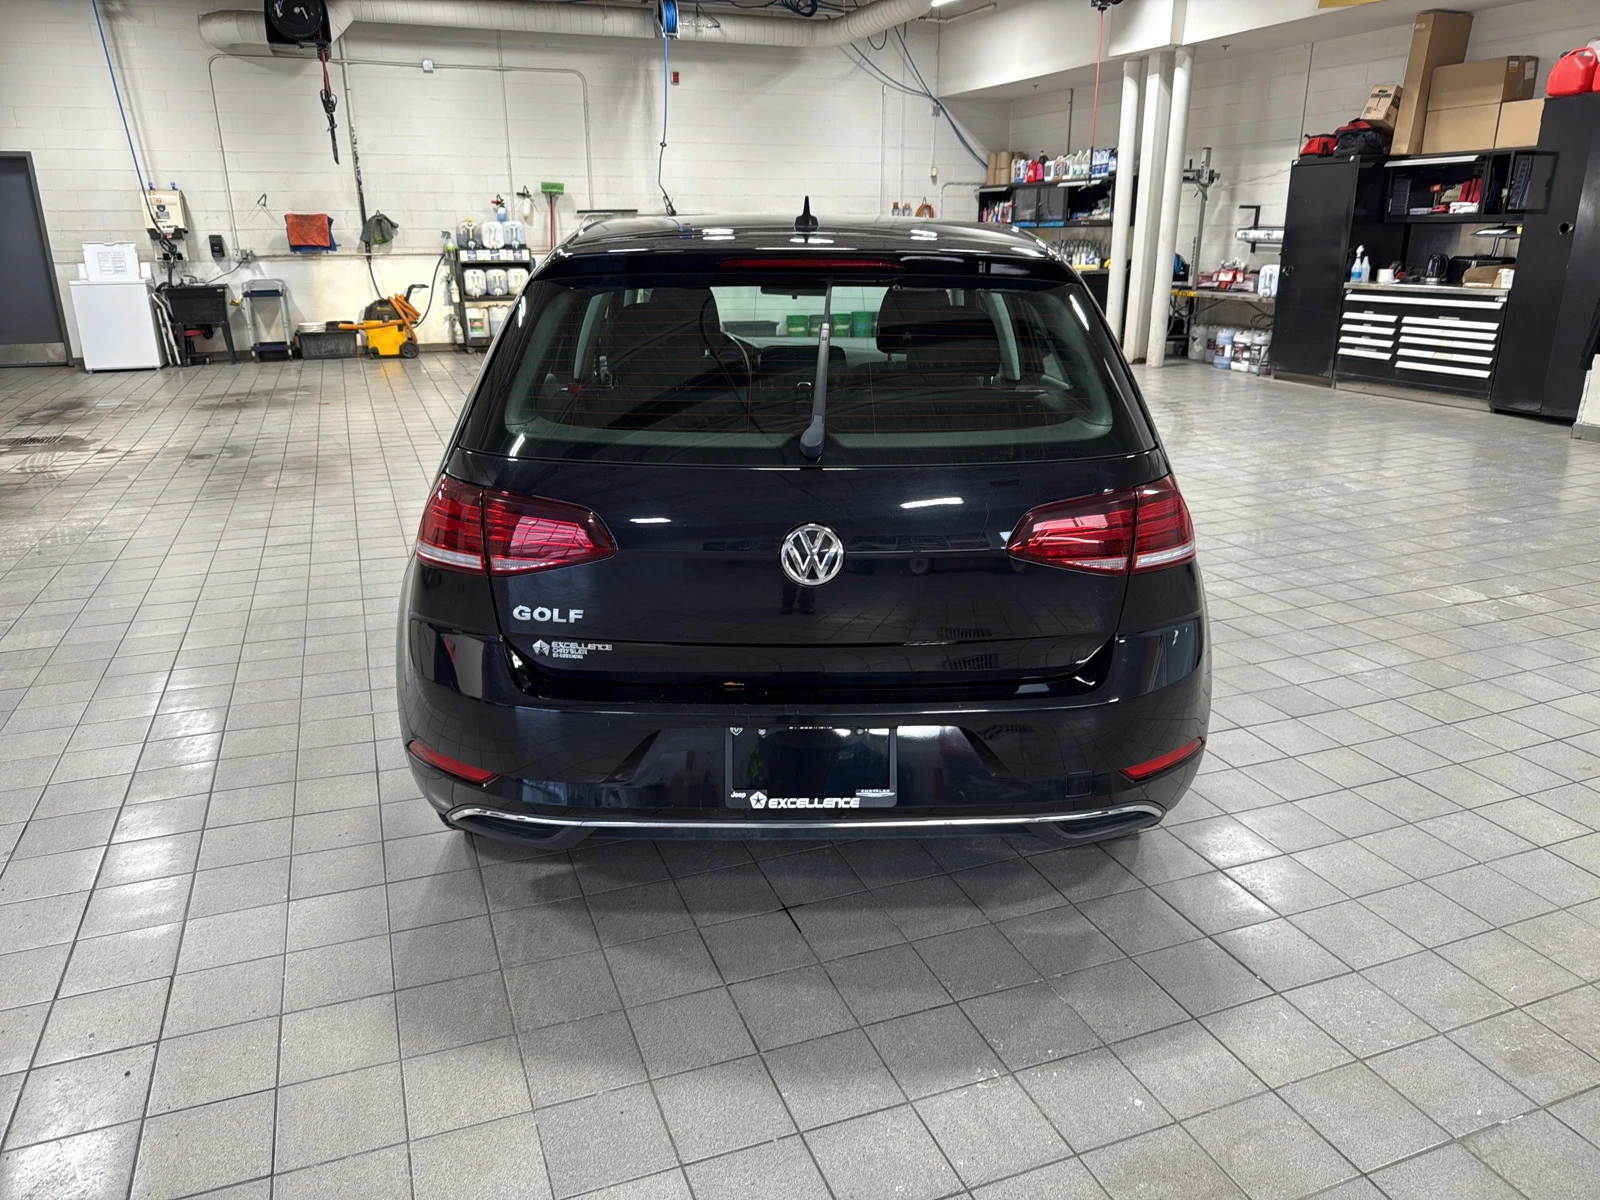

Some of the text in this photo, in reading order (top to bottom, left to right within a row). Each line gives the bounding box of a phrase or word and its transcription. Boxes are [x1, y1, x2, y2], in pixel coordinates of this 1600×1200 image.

[512, 605, 584, 623] GOLF
[551, 641, 613, 651] EXCELLENCE
[730, 791, 747, 799] Jeep
[768, 797, 860, 809] EXCELLENCE
